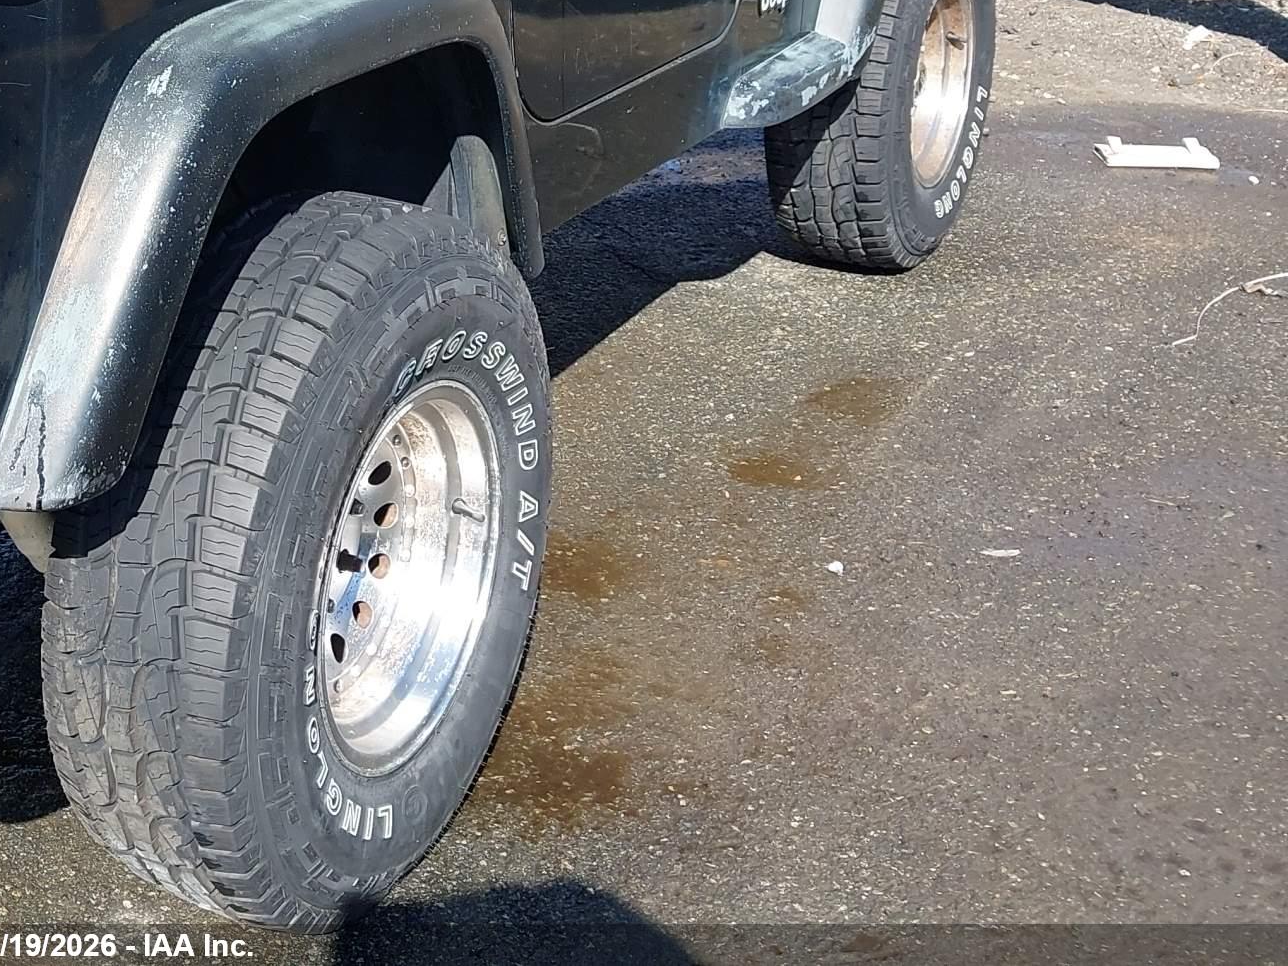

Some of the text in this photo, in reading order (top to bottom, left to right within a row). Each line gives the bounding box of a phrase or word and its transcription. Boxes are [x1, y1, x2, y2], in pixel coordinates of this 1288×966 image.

[933, 85, 988, 220] LINGLONG
[392, 329, 539, 471] CROSSWIND
[511, 490, 539, 592] A/T
[303, 609, 394, 842] LINGLONG
